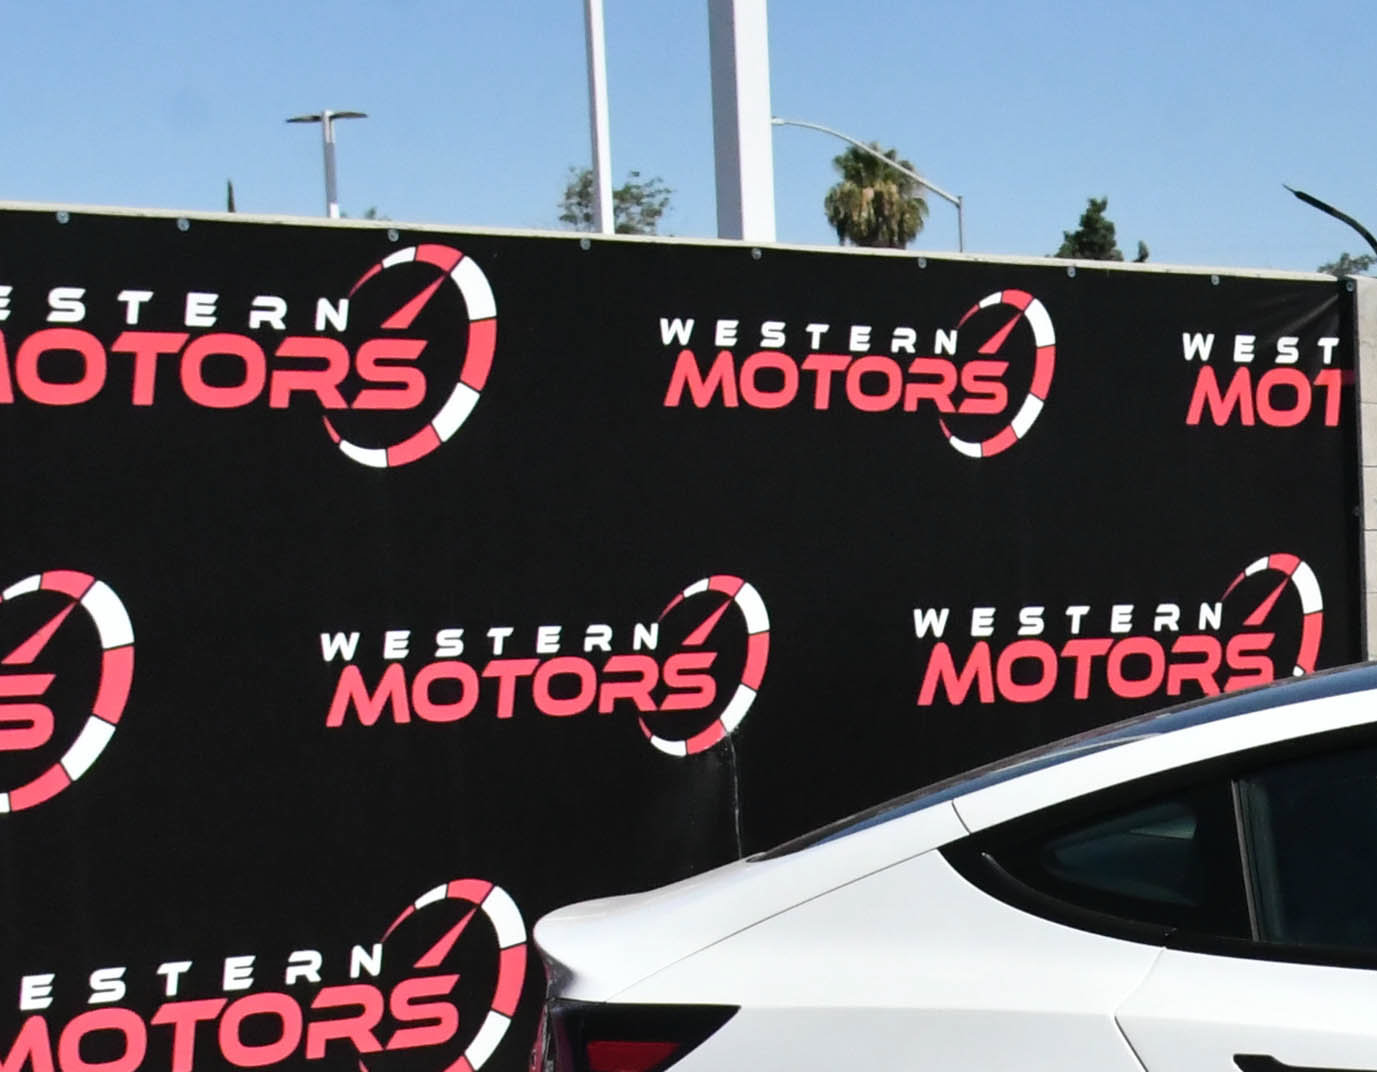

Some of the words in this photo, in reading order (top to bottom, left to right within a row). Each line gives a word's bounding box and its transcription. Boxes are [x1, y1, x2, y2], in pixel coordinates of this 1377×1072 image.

[659, 317, 958, 356] WESTERN
[1182, 332, 1340, 365] WEST
[0, 327, 428, 410] OTORS
[663, 349, 1009, 415] MOTORS
[320, 622, 660, 662] WESTERN
[913, 602, 1223, 639] WESTERN
[325, 651, 718, 729] MOTORS
[917, 632, 1275, 706] MOTORS
